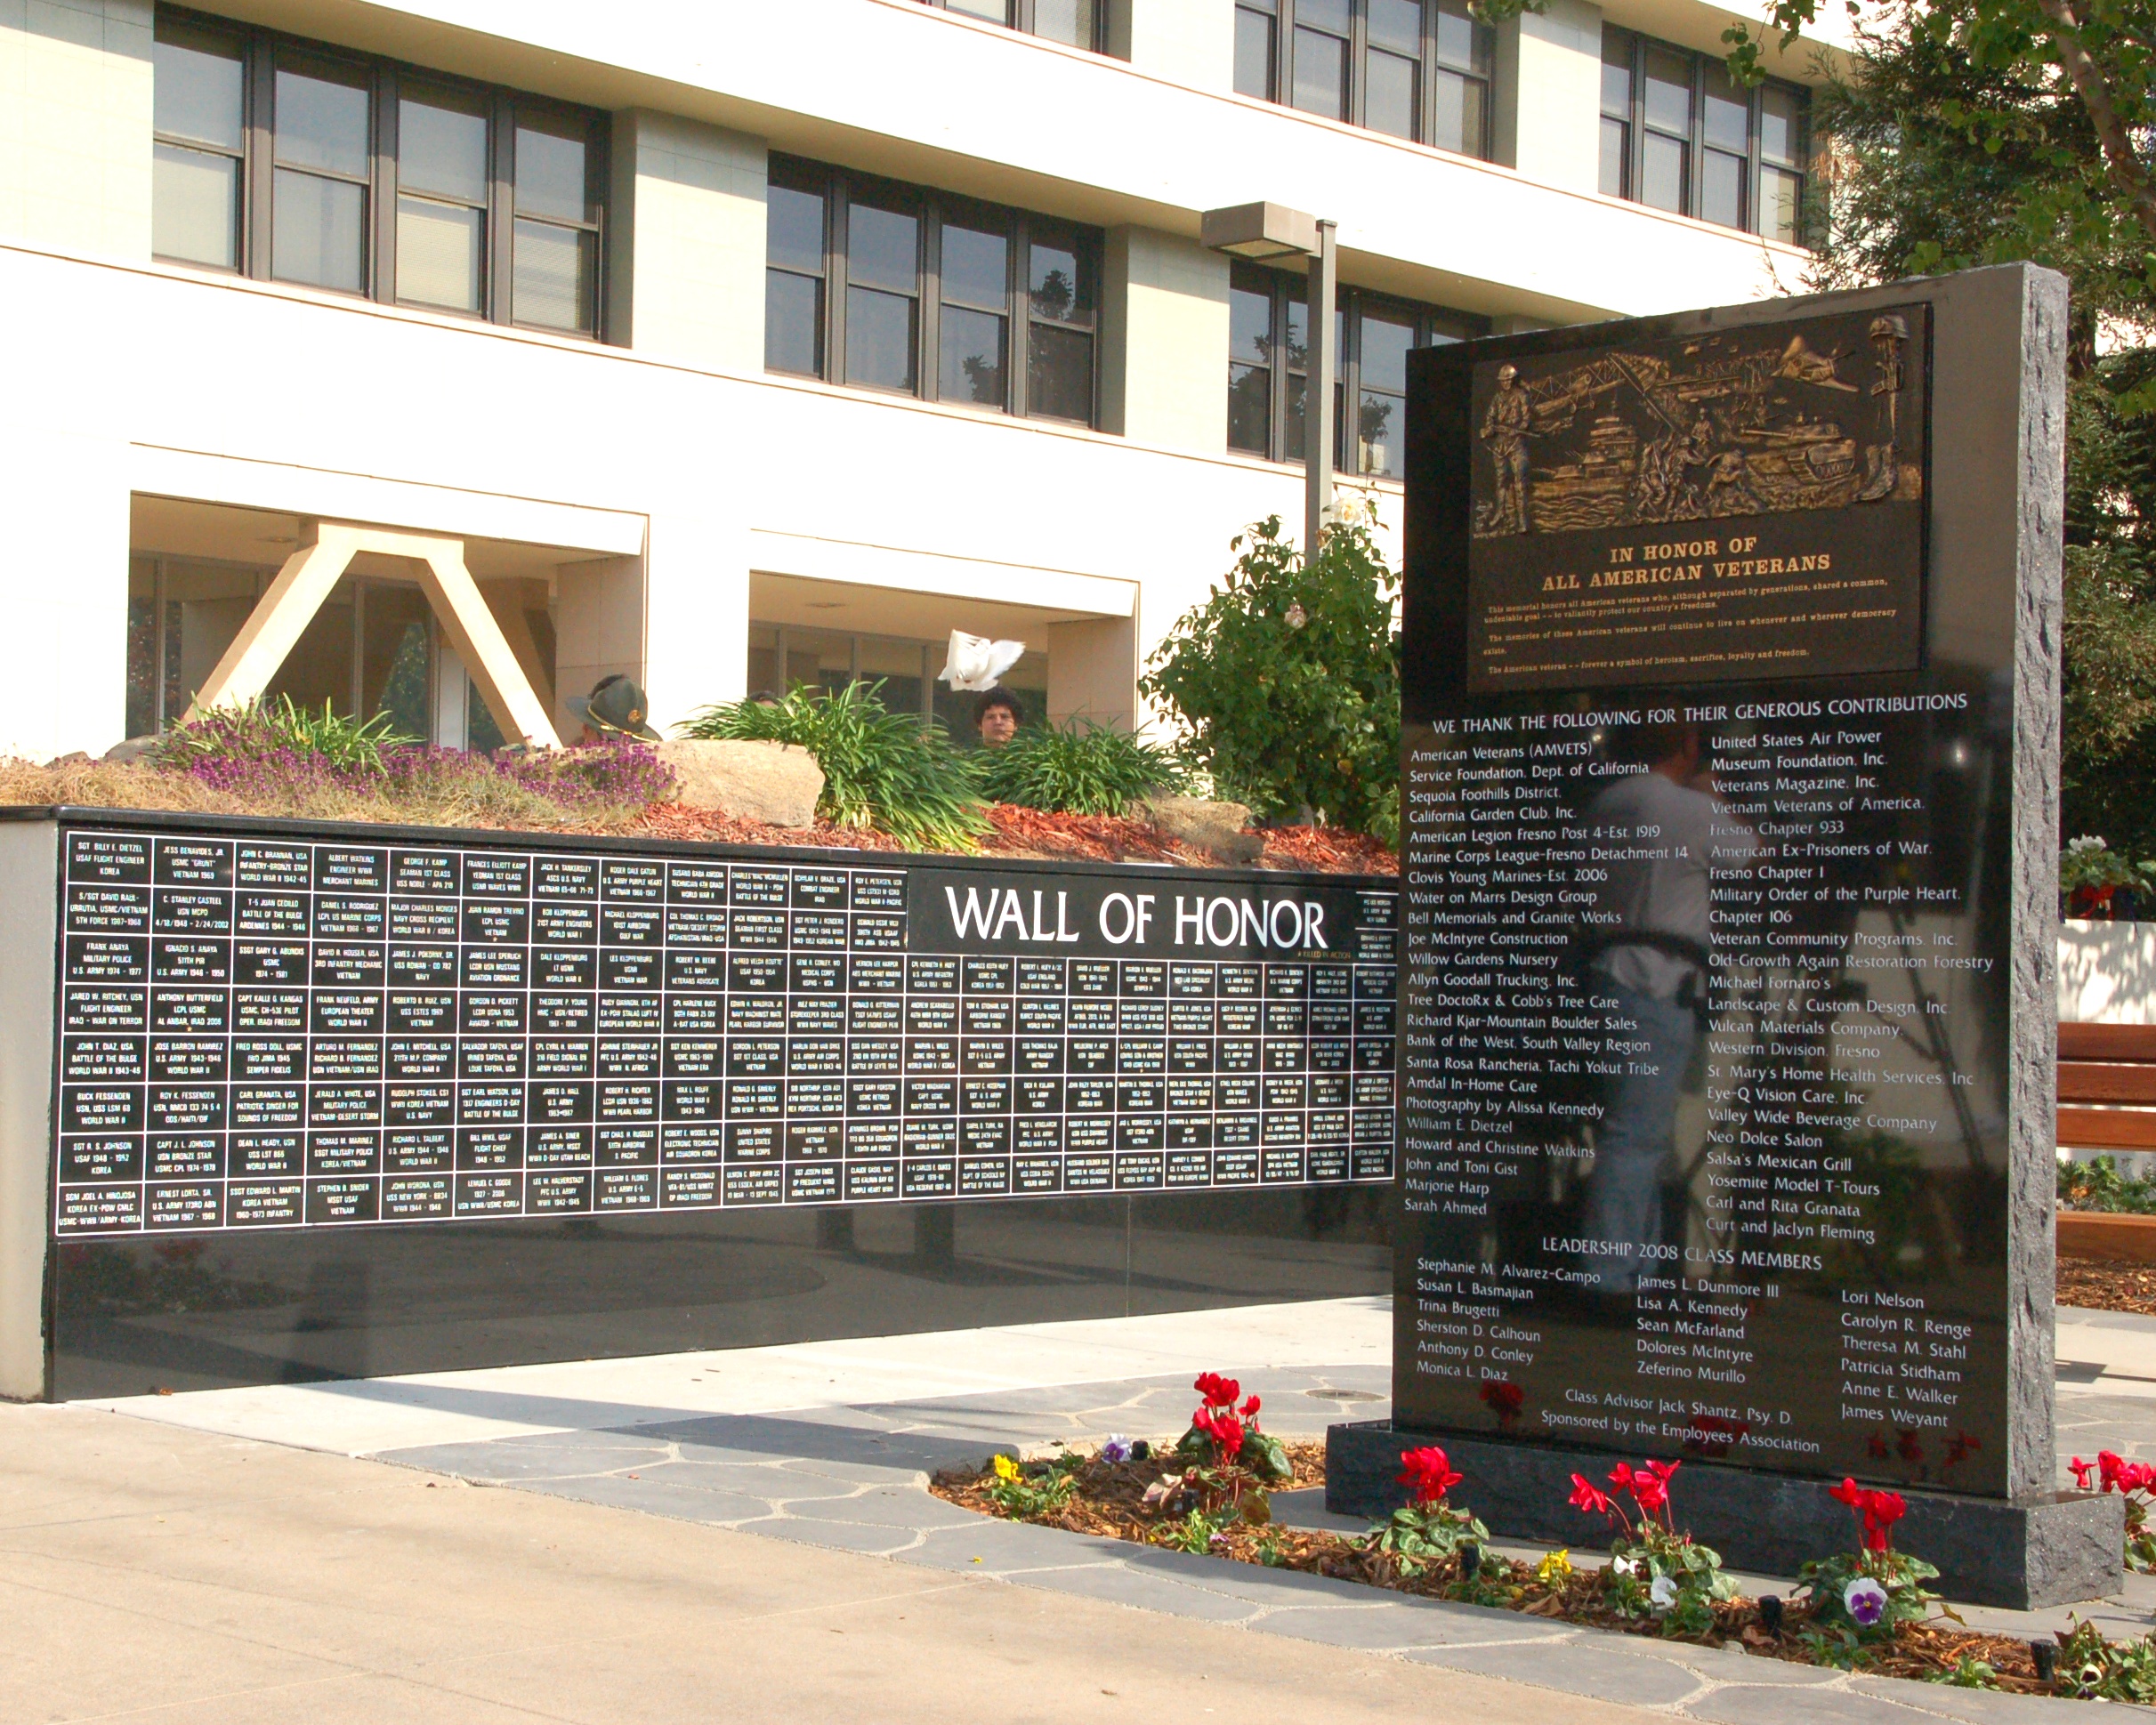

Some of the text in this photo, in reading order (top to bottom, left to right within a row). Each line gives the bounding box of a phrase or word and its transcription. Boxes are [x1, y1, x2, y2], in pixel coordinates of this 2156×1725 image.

[1610, 536, 1757, 562] IN HONOR OF
[1541, 554, 1830, 591] ALL AMERICAN VETERANS
[1433, 693, 1967, 734] WE THANK THE FOLLOWING FOR THEIR GENEROUS CONTRIBUTIONS
[1711, 731, 1882, 749] United States Air Power
[1410, 741, 1592, 762] American Veterans (AMVETS)
[1409, 830, 1466, 844] American
[1472, 828, 1513, 845] Legion
[1517, 828, 1556, 841] Fresno
[1562, 827, 1587, 840] Post
[1636, 825, 1660, 837] 1919
[1408, 872, 1444, 884] Clovis
[1449, 871, 1487, 887] Young
[1574, 868, 1608, 882] 2006
[1409, 890, 1597, 907] Water on Marrs Design Group
[944, 886, 1080, 942] WALL
[1099, 892, 1156, 944] OF
[1174, 895, 1328, 949] HONOR
[1709, 910, 1793, 926] Chapter 106
[1408, 932, 1426, 947] Joe
[1431, 932, 1485, 947] McIntyre
[1490, 931, 1568, 945] Construction
[1408, 994, 1619, 1008] Tree DoctoRx & Cobb's Tree Care
[1407, 1013, 1452, 1027] Richard
[1457, 1014, 1546, 1029] Kjar-Mountain
[1551, 1016, 1600, 1029] Boulder
[1604, 1017, 1637, 1030] Sales
[1407, 1076, 1538, 1092] Amdal In-Home Care
[1406, 1096, 1604, 1119] Photography by Alissa Kennedy
[1708, 1108, 1937, 1133] Valley Wide Beverage Company
[1405, 1137, 1595, 1158] Howard and Christine Watkins
[1707, 1130, 1822, 1148] Neo Dolce Salon
[1707, 1151, 1852, 1171] Salsa's Mexican Grill
[1708, 1173, 1880, 1196] Yosemite Model T-Tours
[1404, 1197, 1487, 1215] Sarah Ahmed
[1706, 1218, 1876, 1245] Curt and Jaclyn Fleming
[1542, 1237, 1822, 1270] LEADERSHIP 2008 CLASS MEMBERS
[1417, 1298, 1499, 1319] Trina Brugetti
[1636, 1317, 1745, 1339] Sean McFarland
[1636, 1360, 1746, 1383] Zeferino Murillo
[1841, 1358, 1961, 1382] Patricia Stidham
[1842, 1381, 1881, 1397] Anne
[1905, 1387, 1958, 1405] Walker
[1541, 1409, 1820, 1453] Sponsored by the Employees Association
